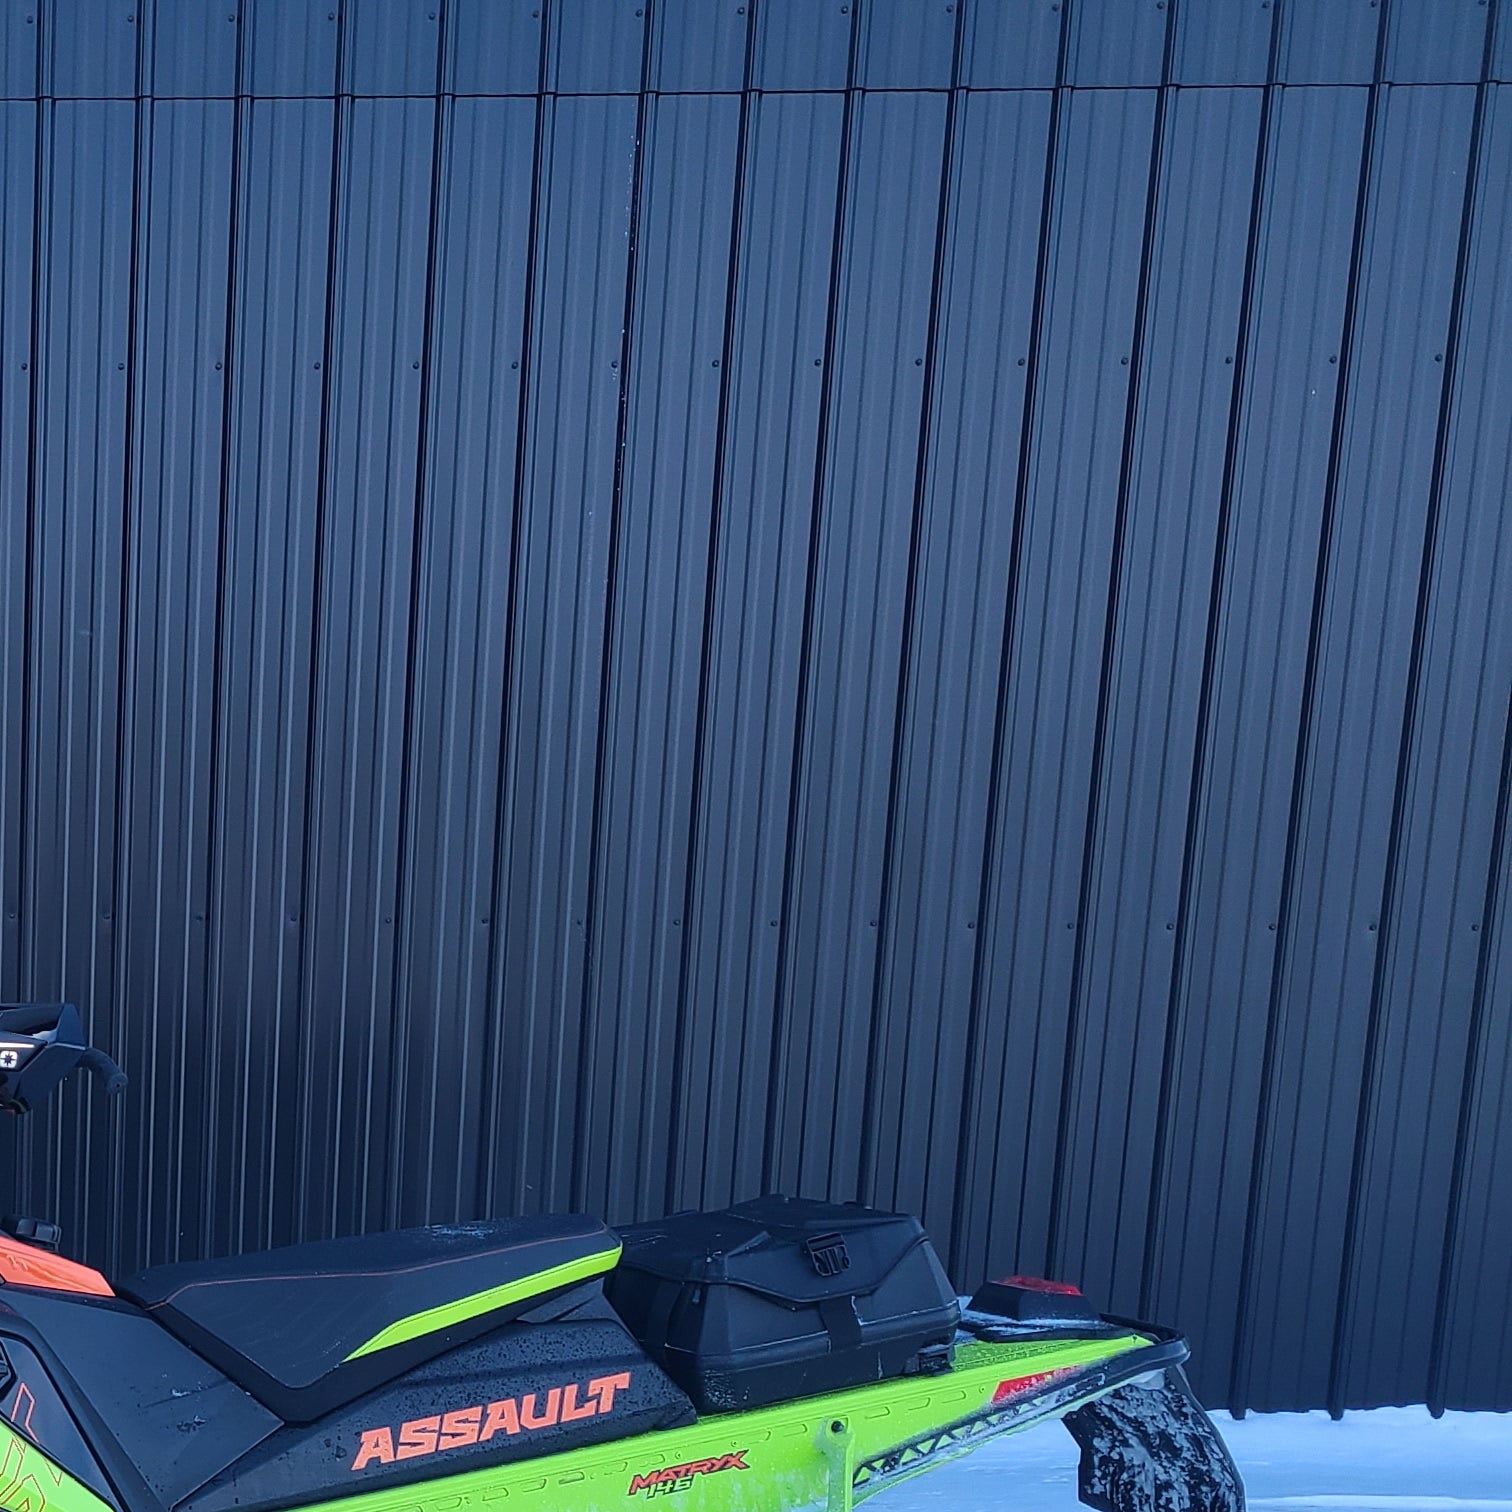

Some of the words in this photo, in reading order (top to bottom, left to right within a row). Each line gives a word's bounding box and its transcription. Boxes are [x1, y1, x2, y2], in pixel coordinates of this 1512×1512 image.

[351, 1372, 631, 1471] ASSAULT
[628, 1449, 750, 1496] MATRYX
[646, 1475, 695, 1498] 146
